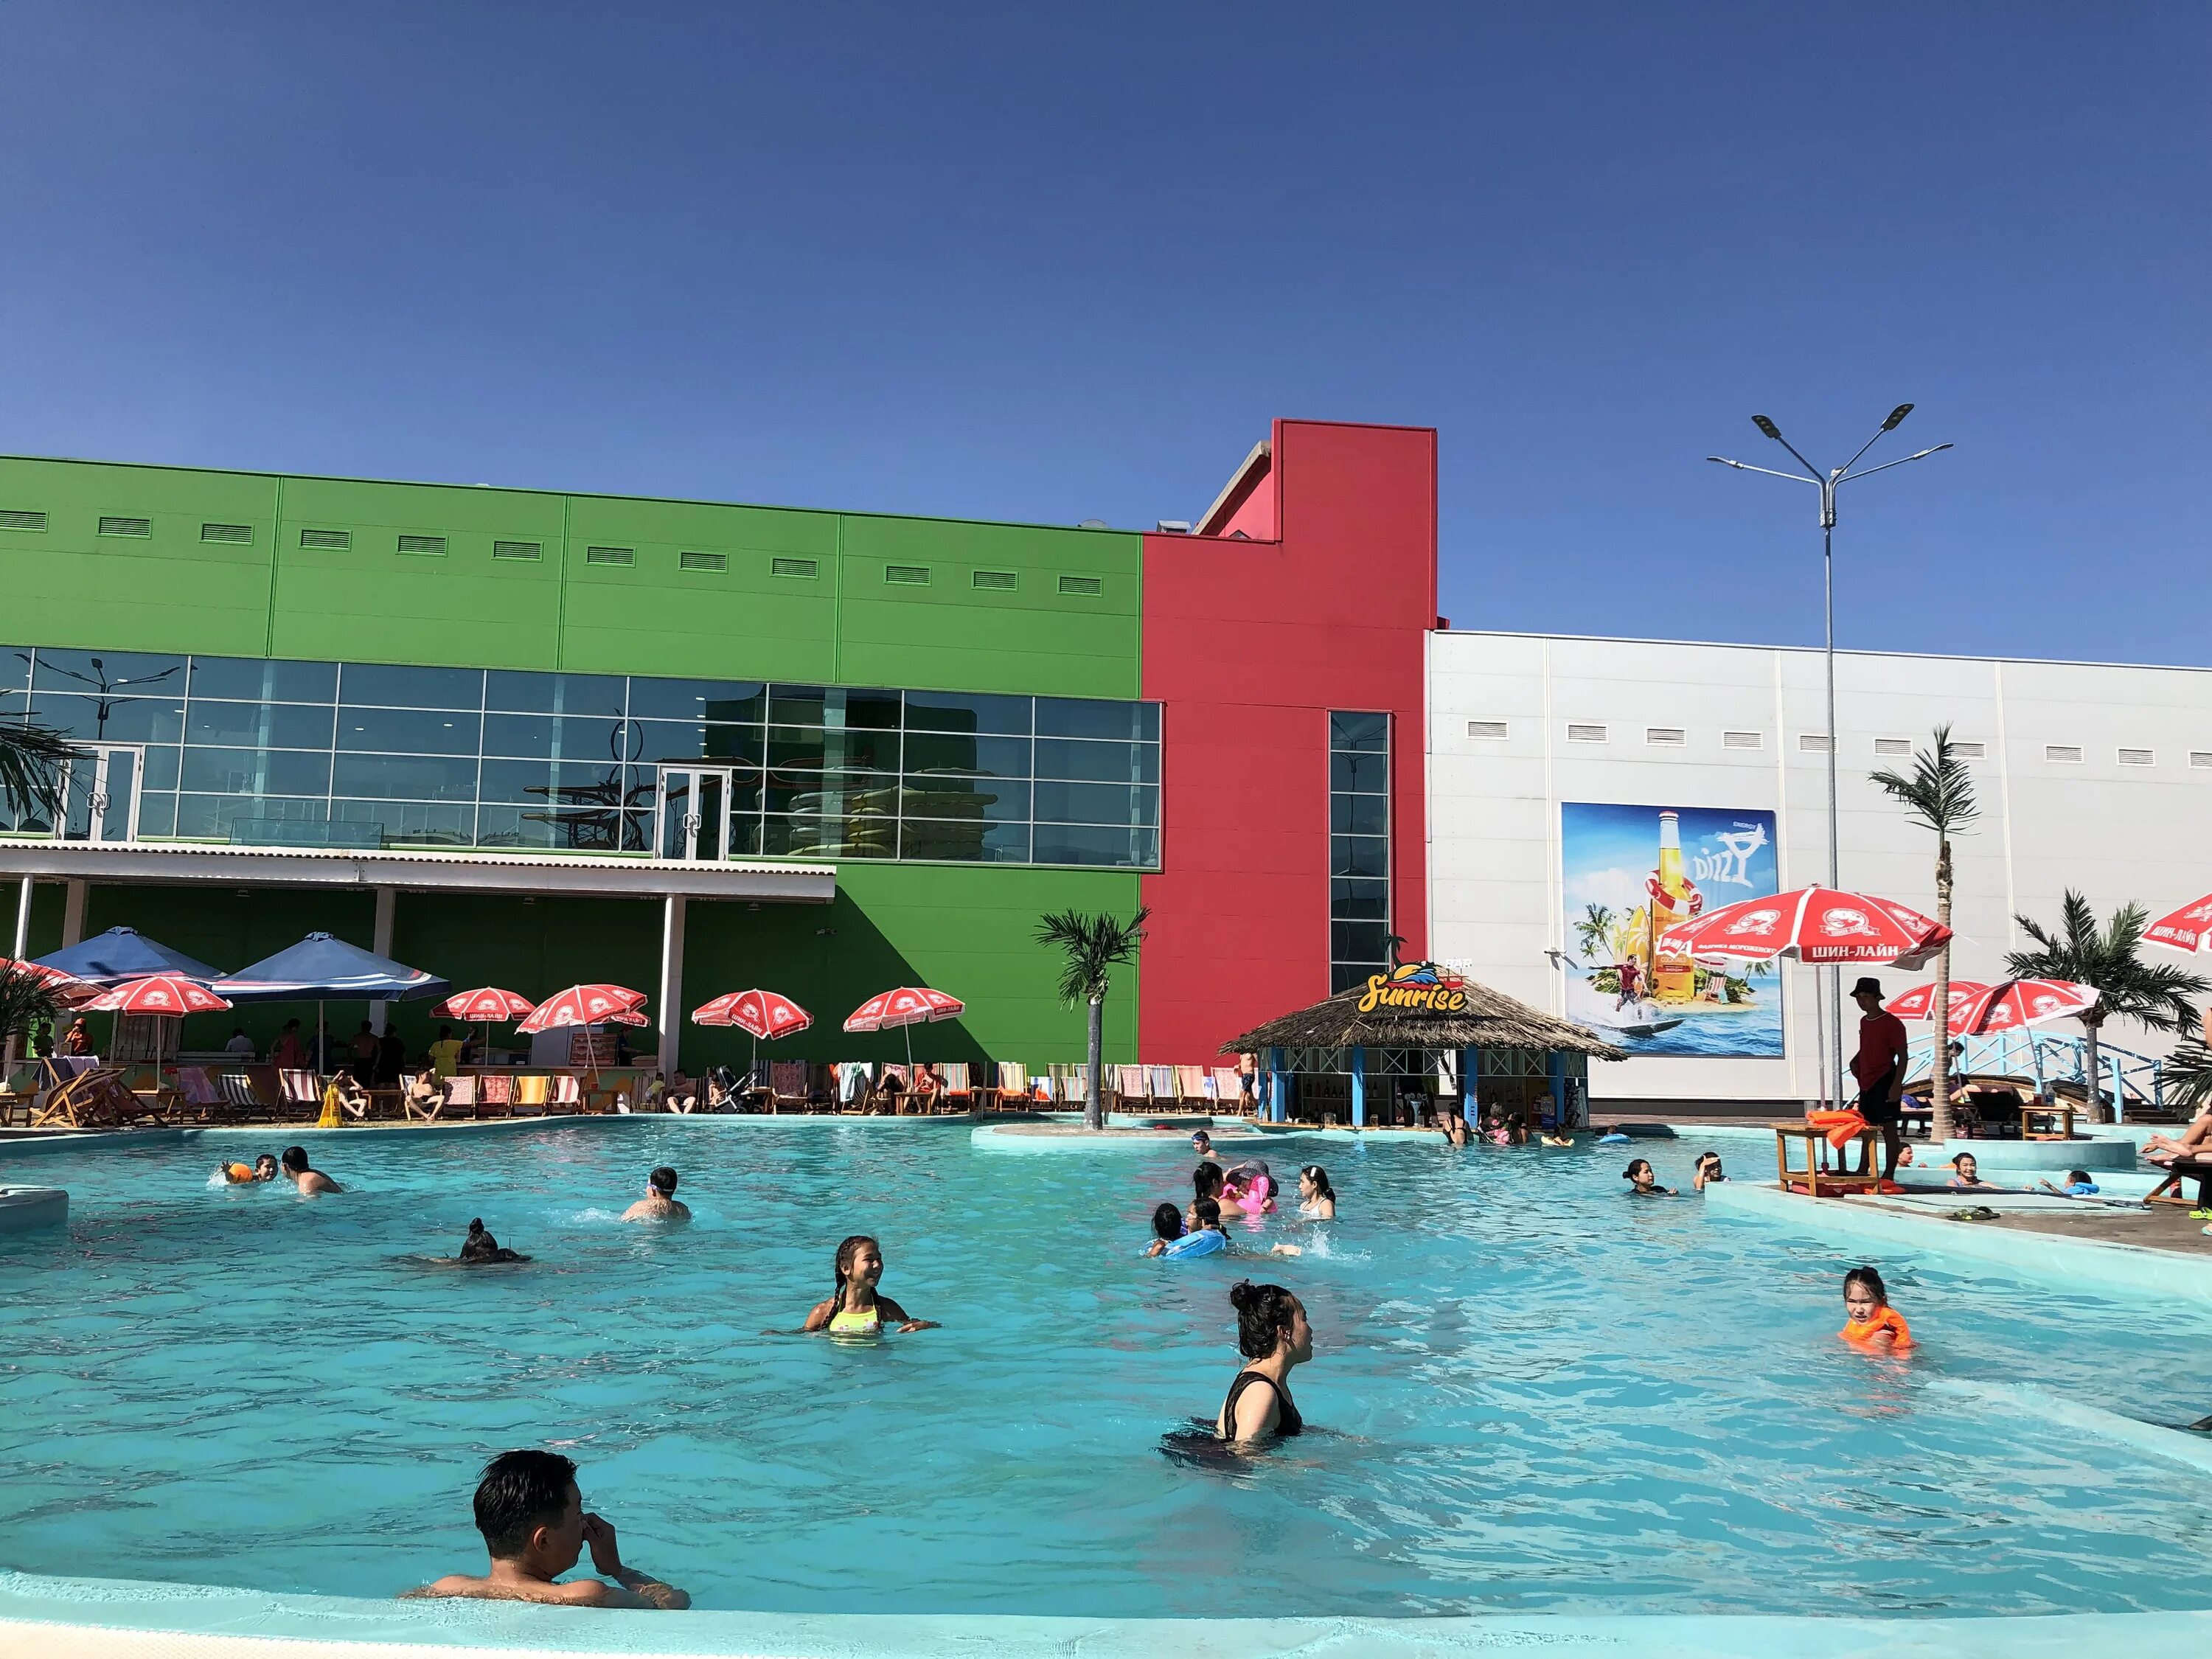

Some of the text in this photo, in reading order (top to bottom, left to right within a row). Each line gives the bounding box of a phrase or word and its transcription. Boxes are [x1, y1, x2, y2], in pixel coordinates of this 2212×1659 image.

[1812, 943, 1899, 958] ШИН-ЛАЙН
[1357, 973, 1467, 1012] Sunrise
[731, 1013, 762, 1034] ШИН-ЛАЙН
